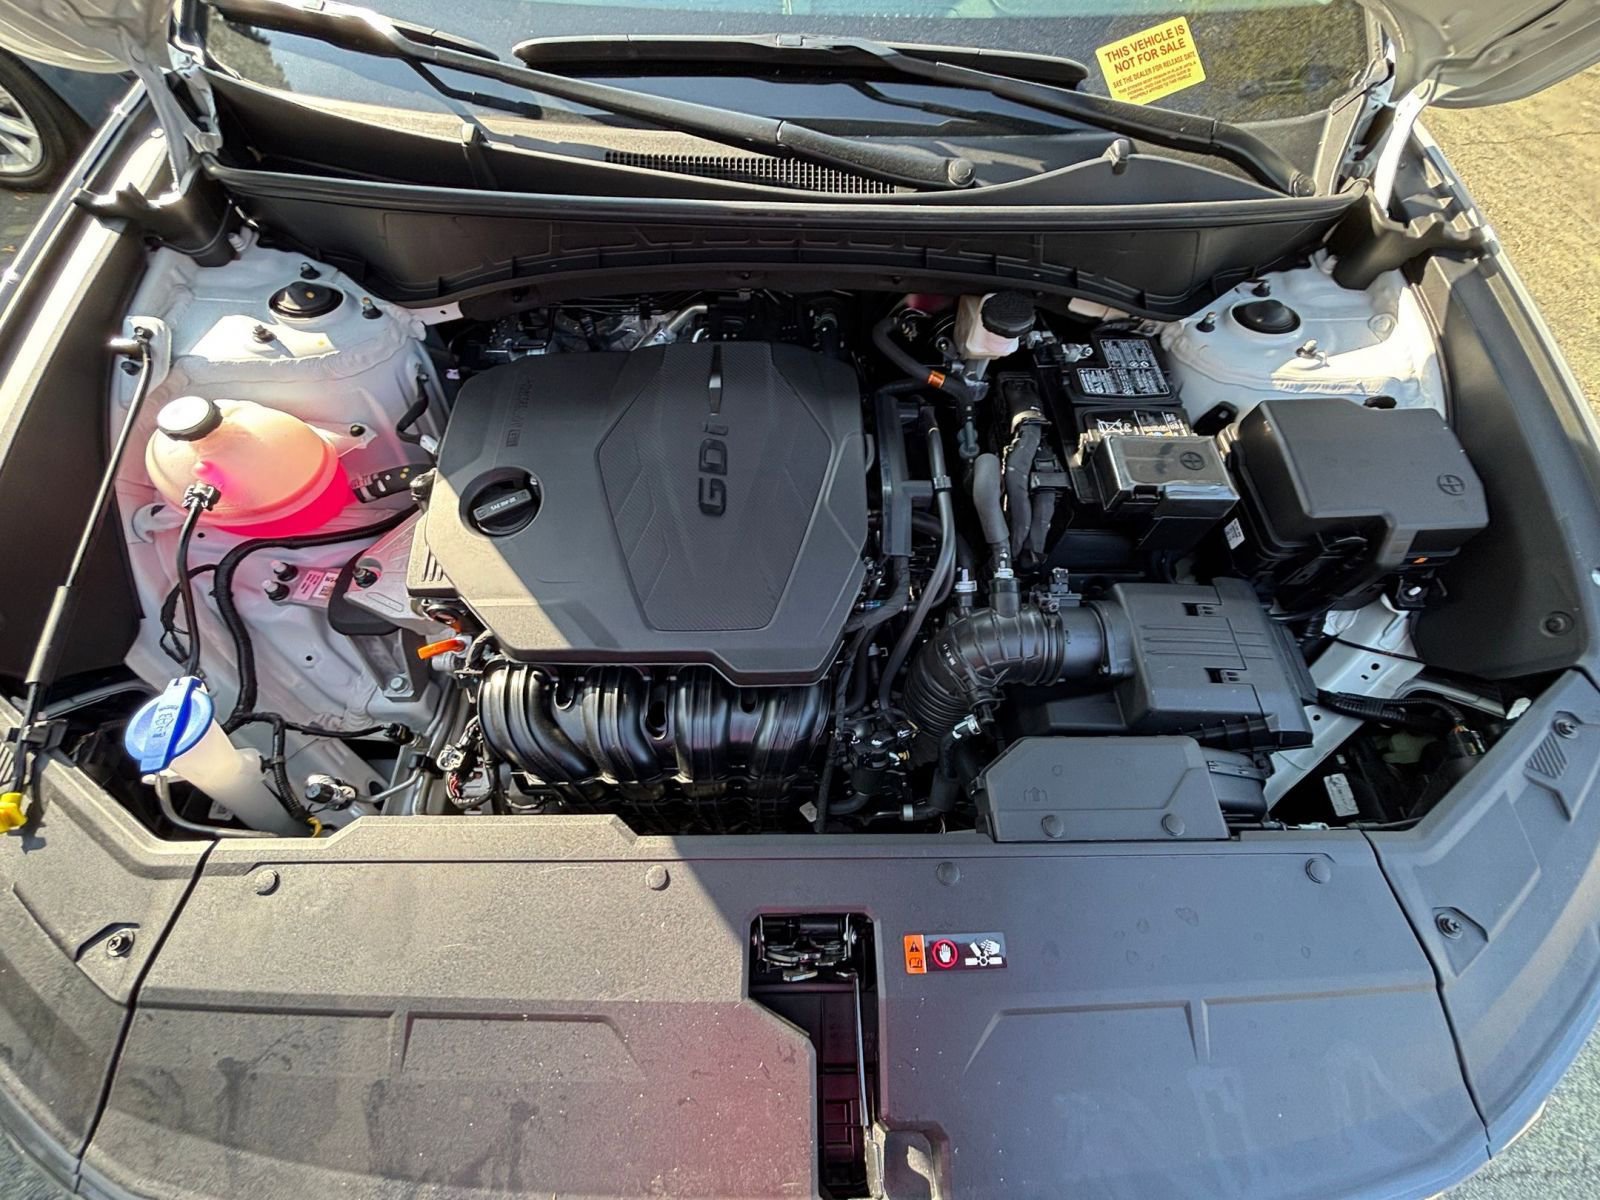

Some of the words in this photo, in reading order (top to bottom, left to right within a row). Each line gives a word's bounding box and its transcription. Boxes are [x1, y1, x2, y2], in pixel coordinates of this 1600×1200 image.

[1105, 46, 1130, 63] THIS
[1130, 28, 1174, 52] VEHICLE
[1175, 24, 1185, 36] IS
[1114, 56, 1136, 74] NOT
[1137, 48, 1160, 65] FOR
[1160, 38, 1186, 55] SALE
[1123, 75, 1133, 85] THE
[1133, 67, 1152, 80] DEALER
[1152, 63, 1163, 75] FOR
[1162, 55, 1184, 68] RELEASE
